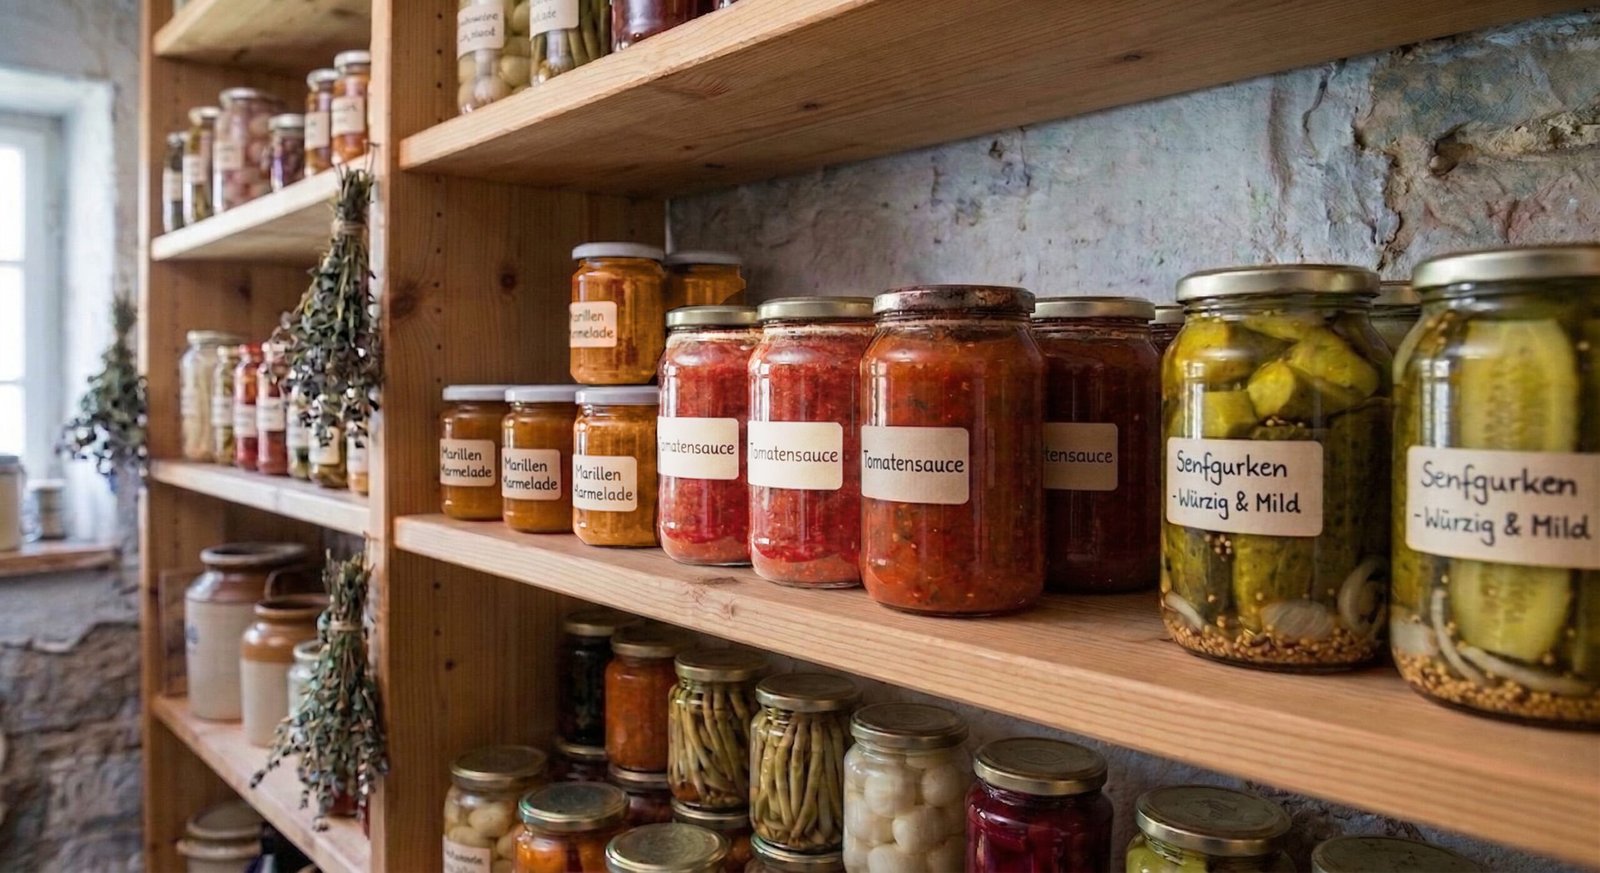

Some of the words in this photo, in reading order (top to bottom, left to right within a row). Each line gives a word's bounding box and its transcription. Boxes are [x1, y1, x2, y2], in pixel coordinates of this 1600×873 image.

[504, 457, 548, 472] Marillen
[864, 450, 964, 473] Tomatensauce
[1045, 449, 1113, 464] tensauce
[1176, 450, 1288, 486] Senfgurken
[575, 464, 621, 481] Marillen
[1421, 460, 1578, 505] Senfgurken
[1236, 490, 1249, 512] &
[1256, 492, 1302, 514] Mild
[1504, 511, 1522, 536] &
[1531, 514, 1591, 540] Mild
